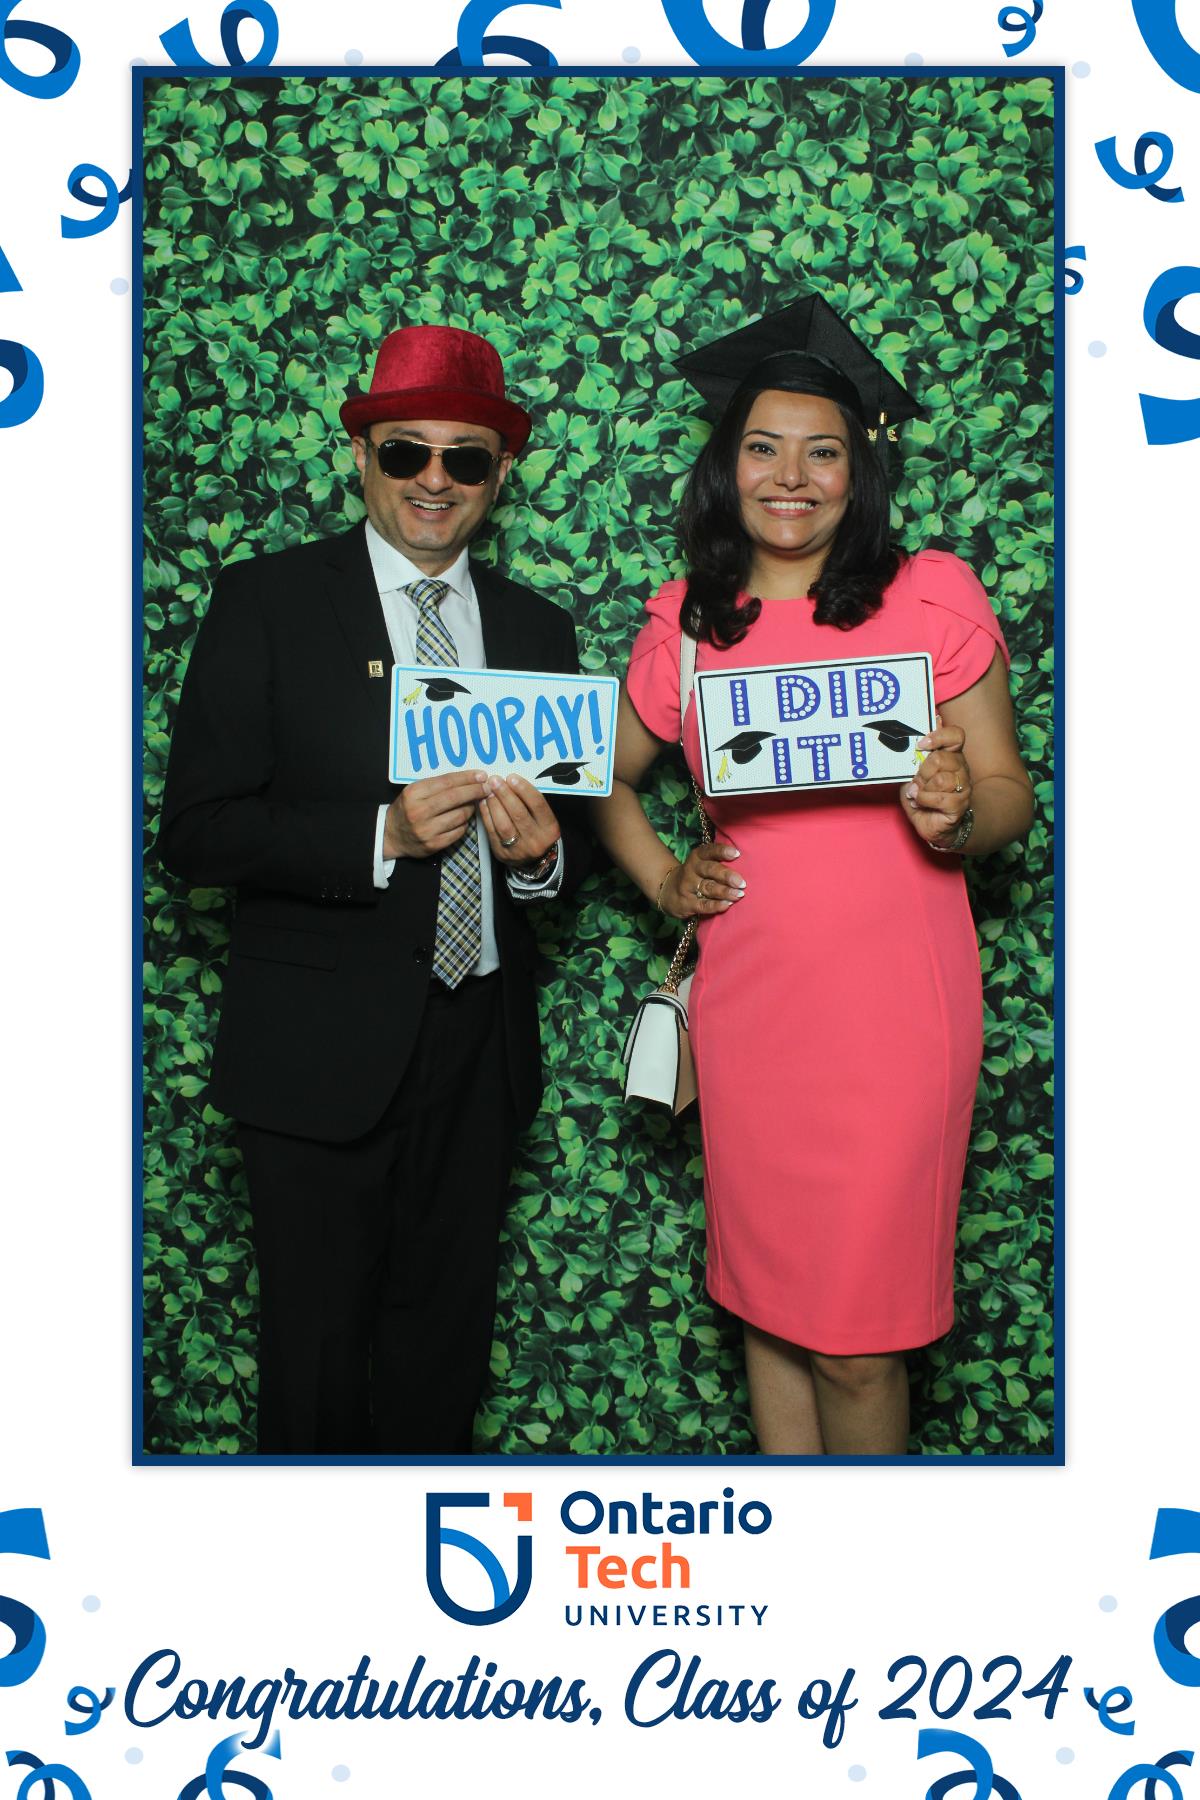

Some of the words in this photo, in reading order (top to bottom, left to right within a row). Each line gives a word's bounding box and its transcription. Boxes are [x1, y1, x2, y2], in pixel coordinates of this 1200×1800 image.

[729, 678, 751, 727] I
[776, 667, 901, 722] DID
[405, 689, 606, 773] HOORAY!
[772, 731, 869, 785] IT!
